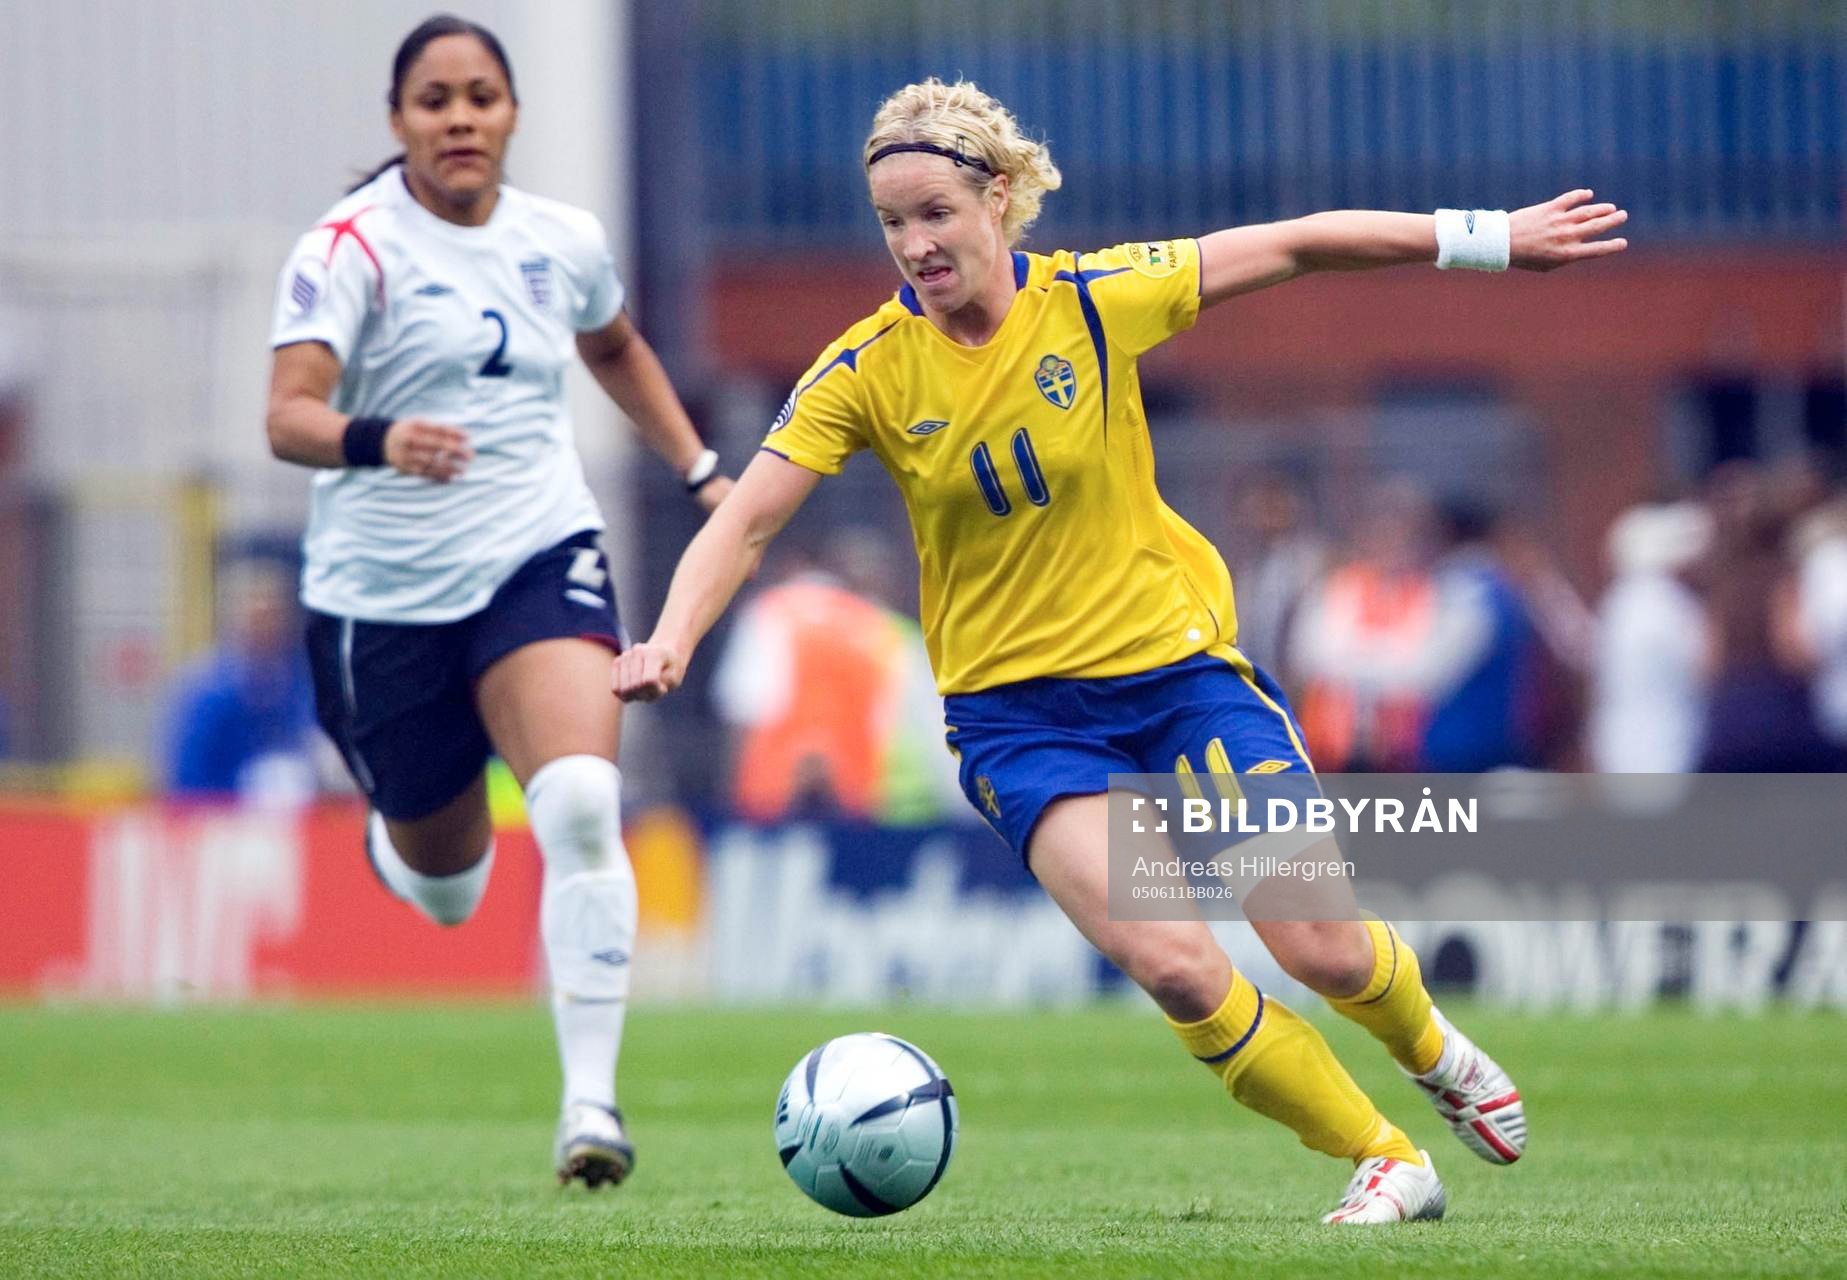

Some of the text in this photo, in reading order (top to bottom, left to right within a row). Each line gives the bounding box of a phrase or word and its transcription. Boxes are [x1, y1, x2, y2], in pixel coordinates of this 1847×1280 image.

[478, 309, 512, 377] 2
[969, 427, 1051, 516] 11
[1175, 737, 1248, 832] 11
